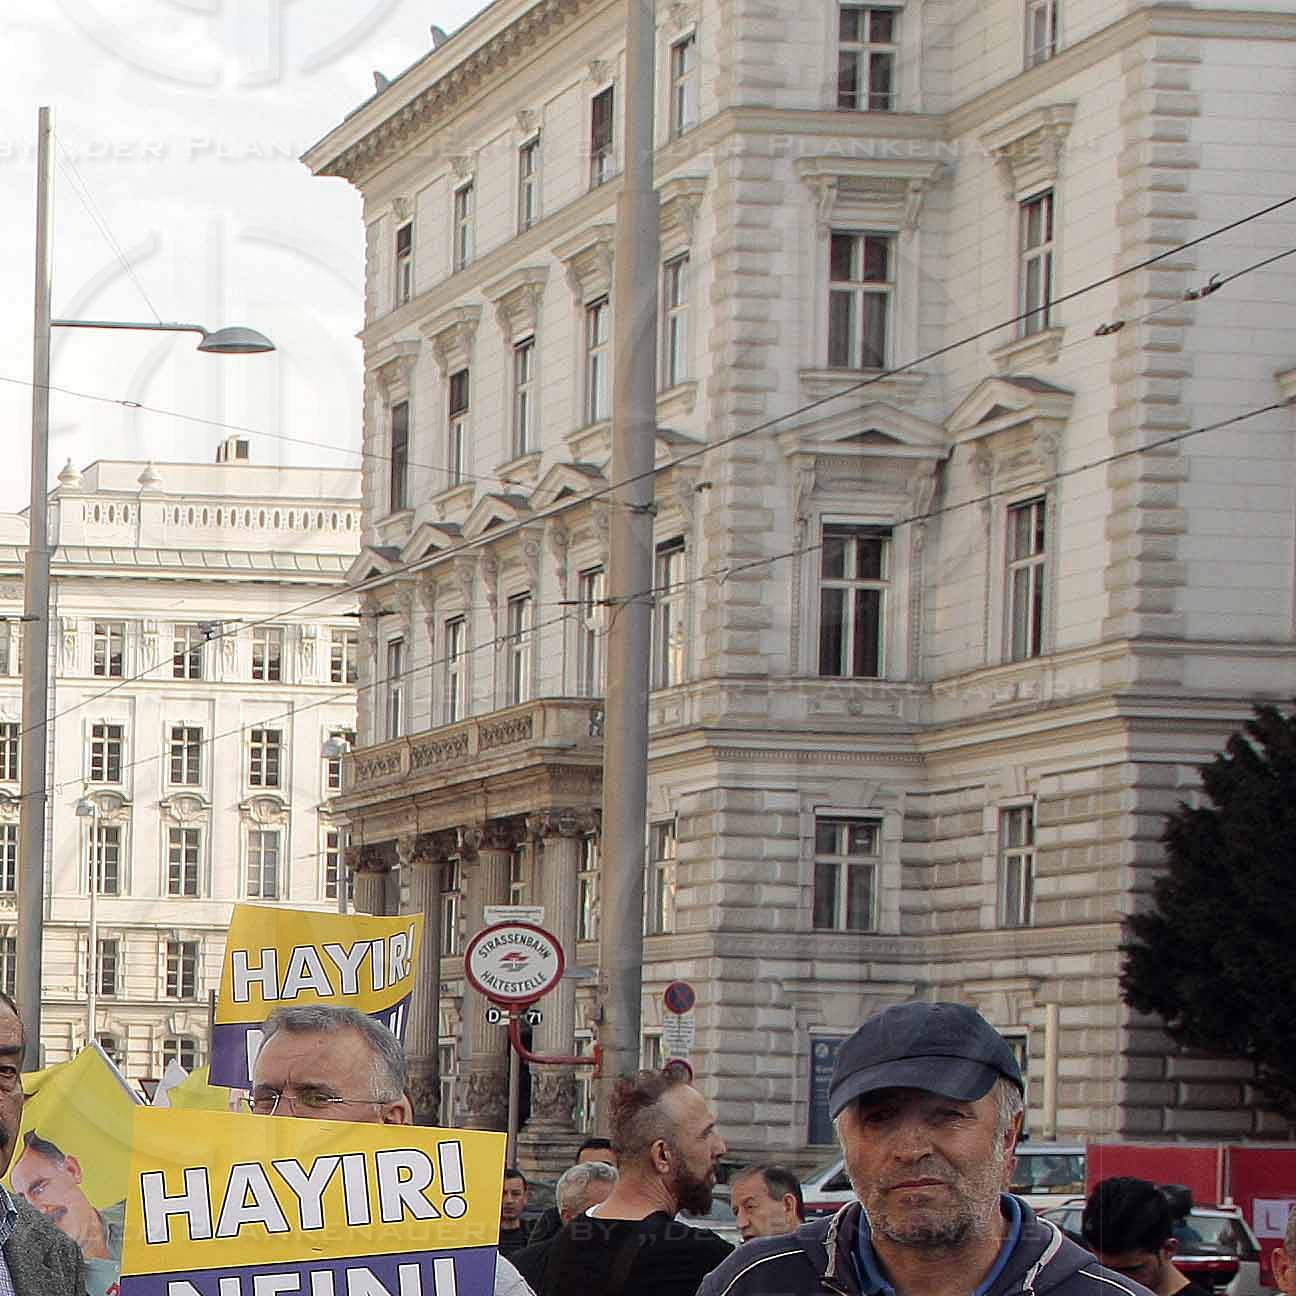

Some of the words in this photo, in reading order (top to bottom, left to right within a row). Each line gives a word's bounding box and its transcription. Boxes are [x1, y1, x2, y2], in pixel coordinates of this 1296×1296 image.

[478, 933, 552, 960] STRASSENBAHN
[231, 922, 416, 1003] HAYIR!
[480, 970, 548, 993] HALTESTELLE
[488, 1008, 501, 1023] D
[528, 1011, 543, 1024] 71
[139, 1140, 469, 1245] HAYIR!
